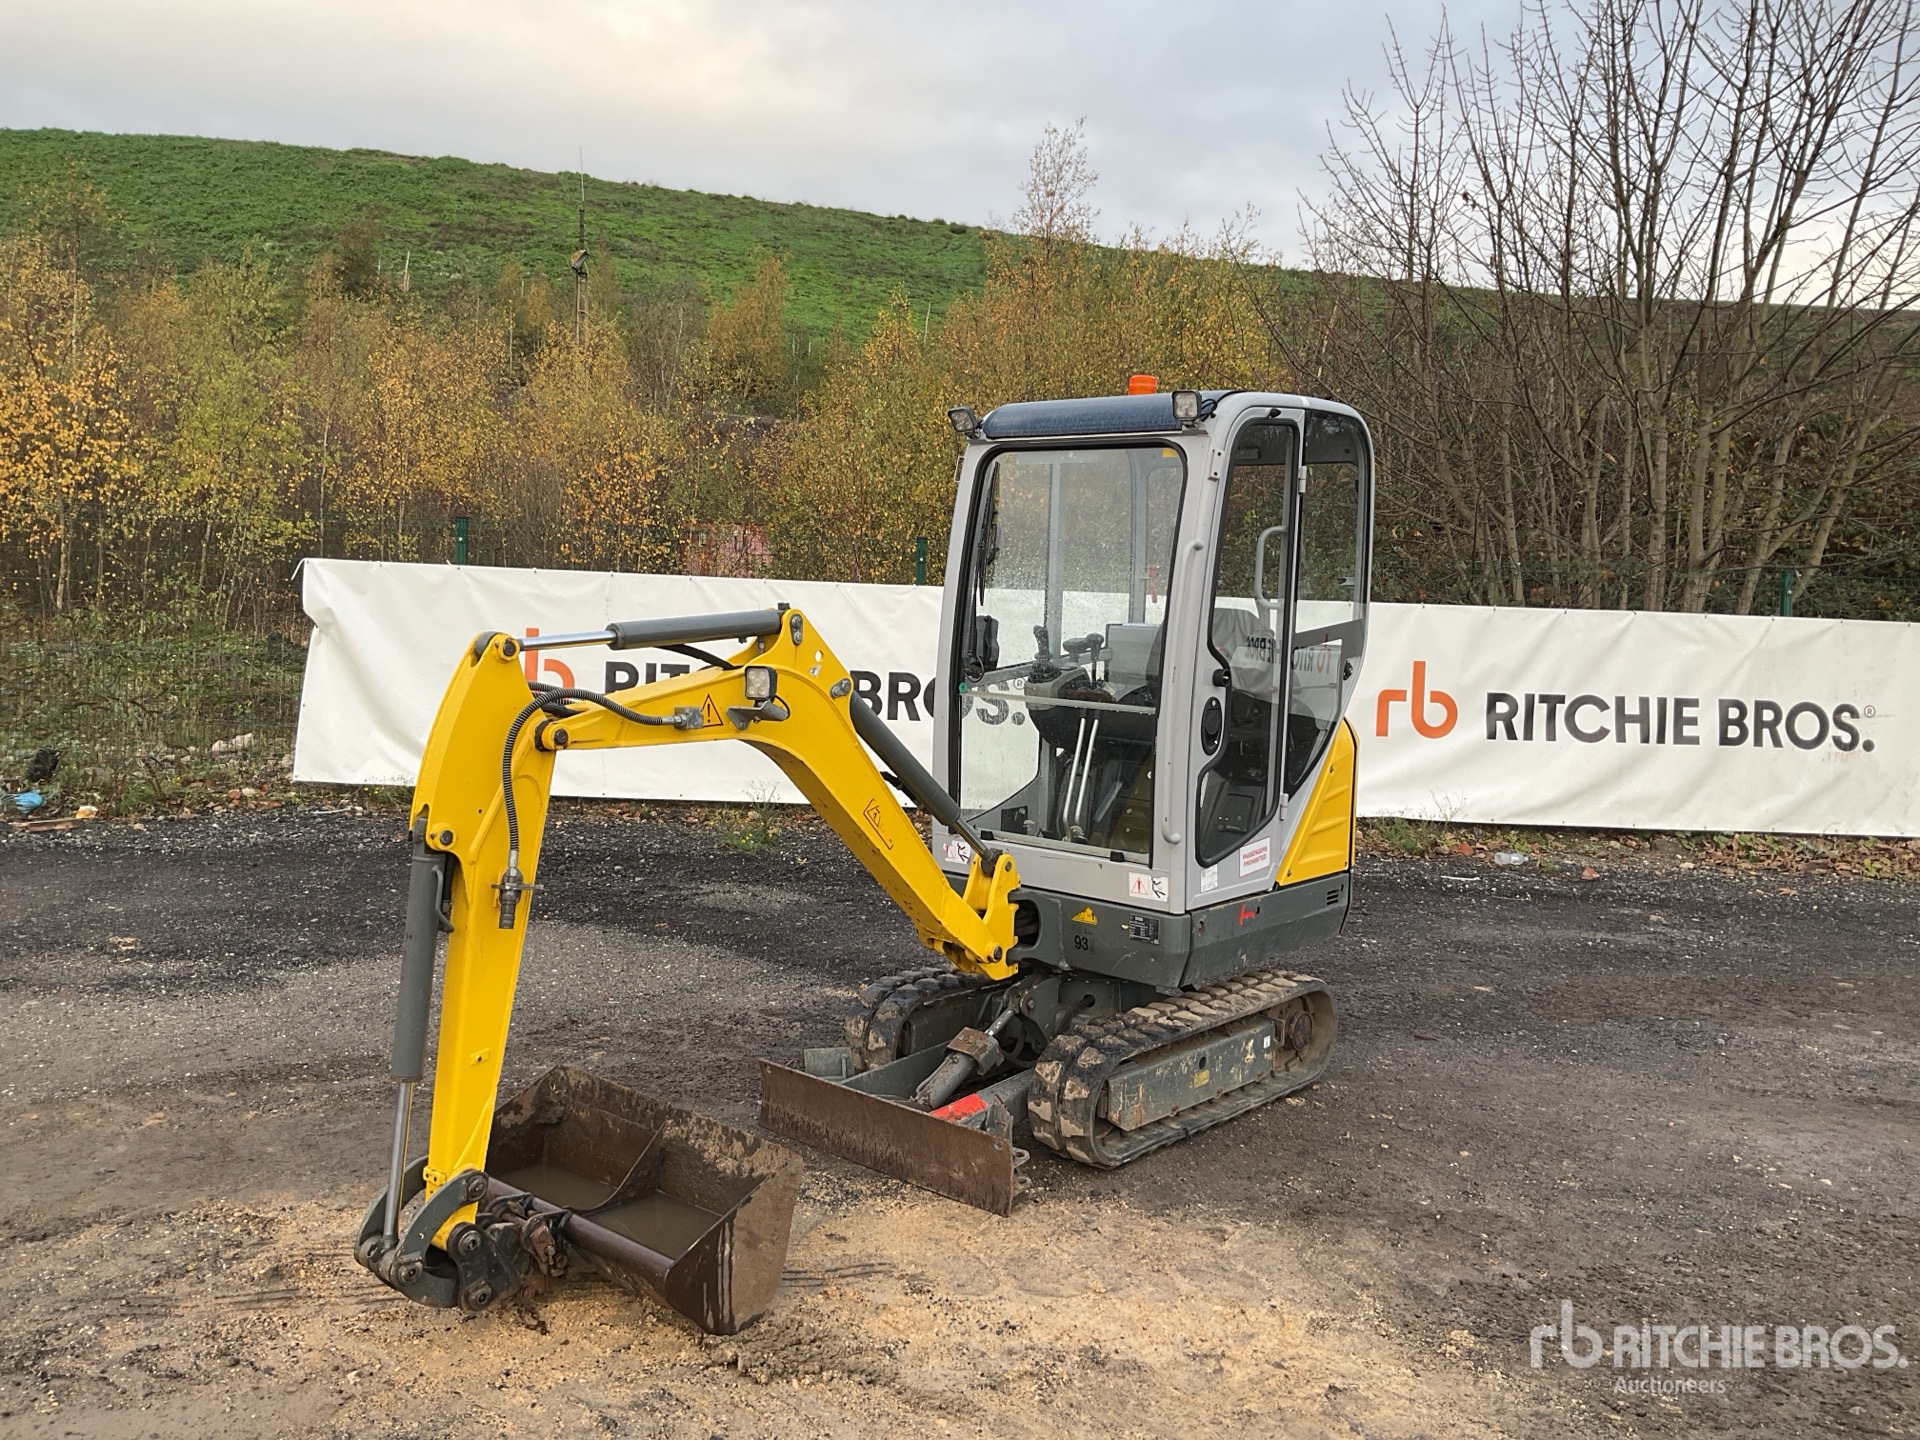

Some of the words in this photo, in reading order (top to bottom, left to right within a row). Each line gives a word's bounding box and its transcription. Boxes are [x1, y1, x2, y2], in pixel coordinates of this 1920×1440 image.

[1376, 661, 1458, 739] rb
[1486, 692, 1700, 745] RITCHIE
[1074, 935, 1089, 951] 93
